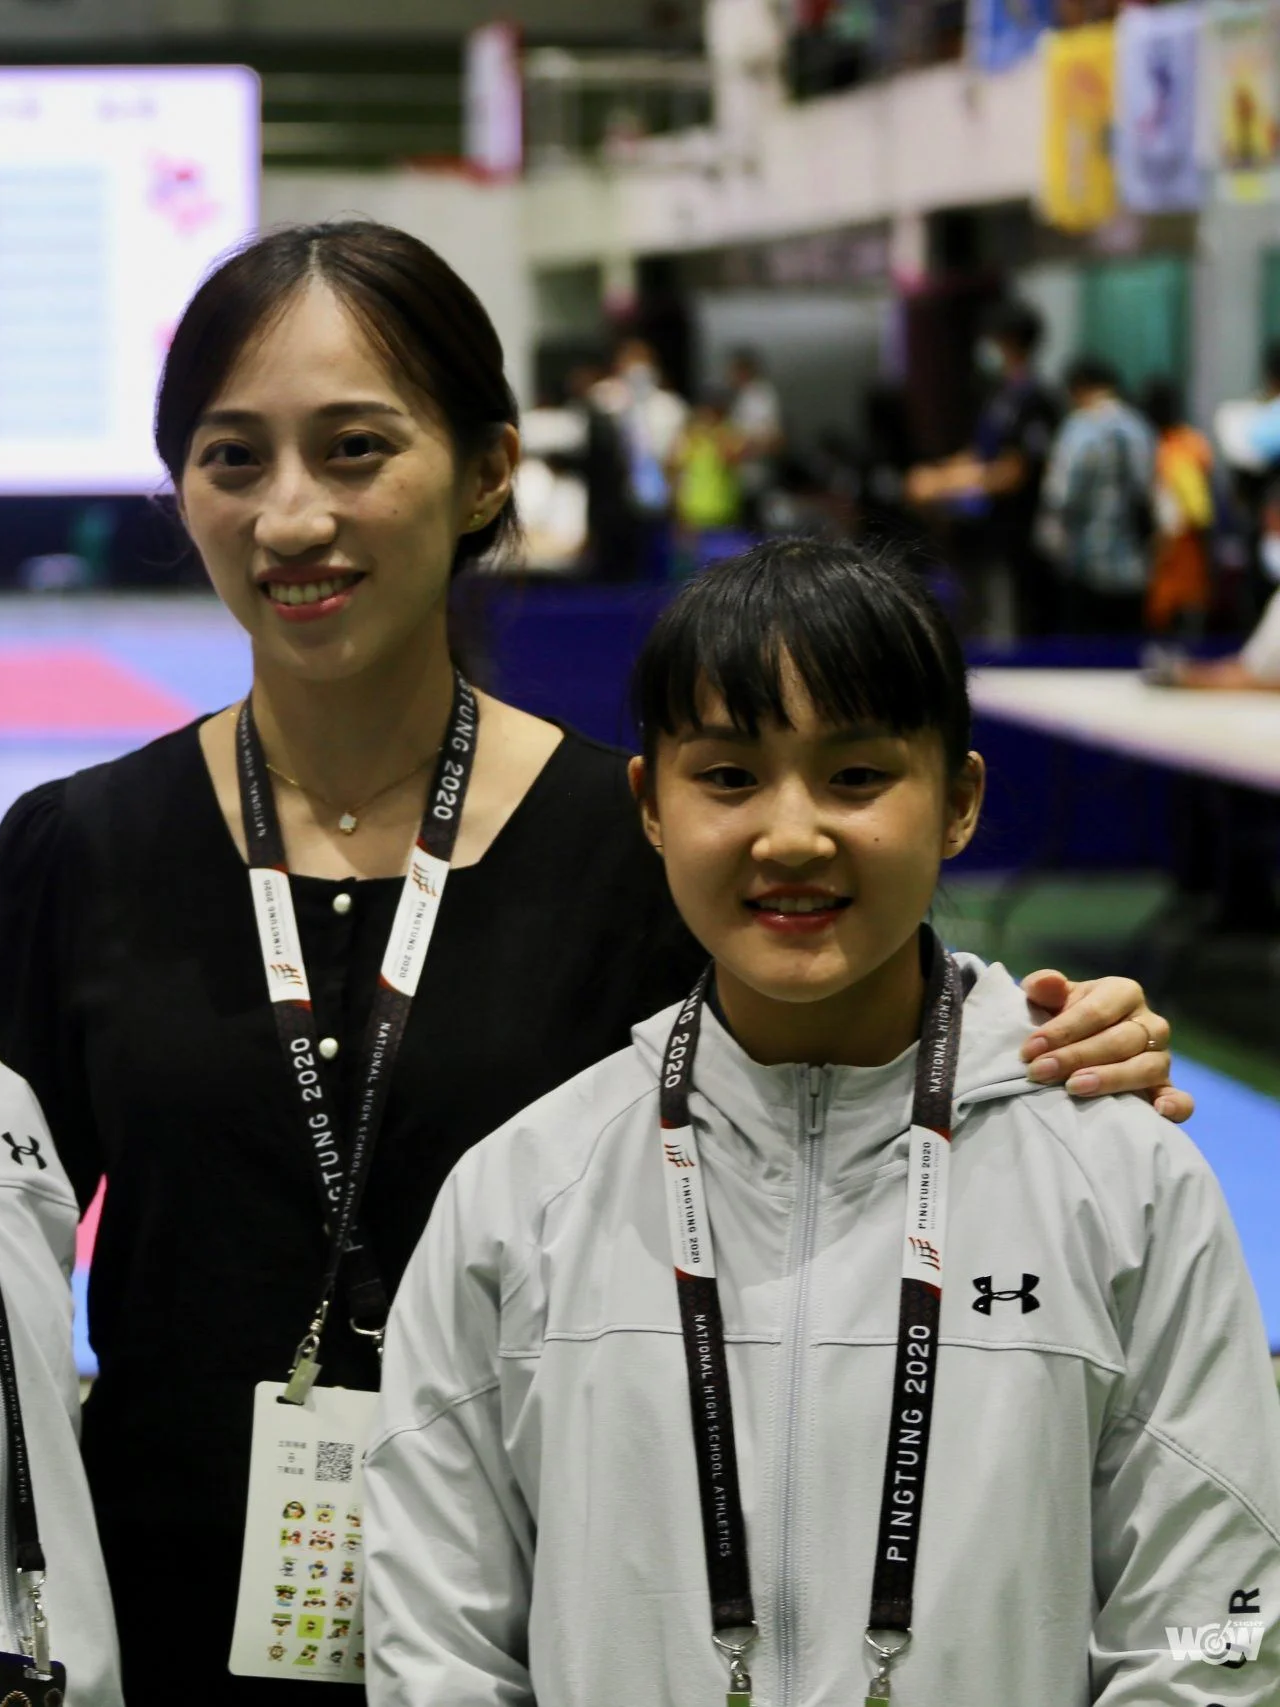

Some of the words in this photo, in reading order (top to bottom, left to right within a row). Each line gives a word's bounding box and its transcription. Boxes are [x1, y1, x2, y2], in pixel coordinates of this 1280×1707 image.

[250, 780, 267, 838] NATIONAL
[433, 761, 464, 820] 2020
[267, 906, 282, 955] PINGTUNG
[407, 901, 426, 951] PINGTUNG
[399, 955, 412, 979] 2020
[937, 1004, 950, 1032] HIGH
[290, 1037, 323, 1101] 2020
[367, 1022, 391, 1083] NATIONAL
[665, 1033, 690, 1088] 2020
[929, 1037, 948, 1093] NATIONAL
[361, 1089, 375, 1121] HIGH
[350, 1127, 368, 1175] SCHOOL
[922, 1141, 932, 1168] 2020
[681, 1177, 697, 1233] PINGTUNG
[689, 1238, 701, 1264] 2020
[918, 1173, 930, 1230] PINGTUNG
[694, 1313, 713, 1380] NATIONAL
[904, 1325, 931, 1394] 2020
[0, 1338, 11, 1375] HIGH
[14, 1435, 28, 1503] ATHLETICS
[703, 1385, 718, 1420] HIGH
[708, 1425, 723, 1480] SCHOOL
[887, 1409, 922, 1562] PINGTUNG
[713, 1486, 732, 1557] ATHLETICS
